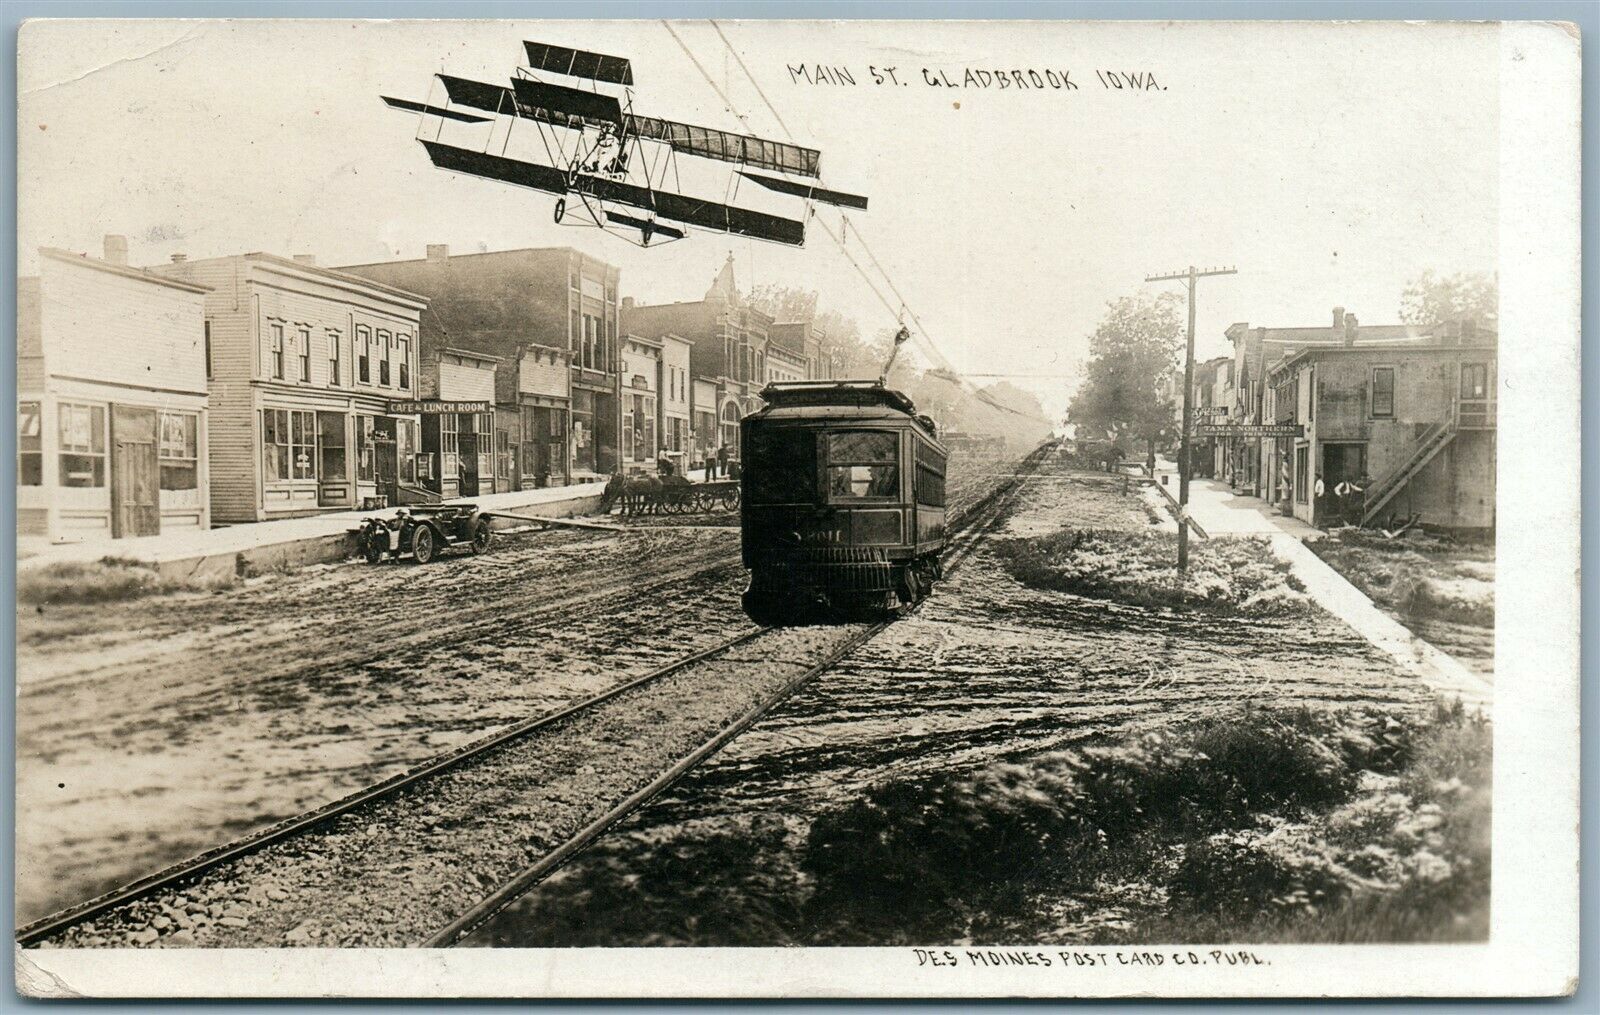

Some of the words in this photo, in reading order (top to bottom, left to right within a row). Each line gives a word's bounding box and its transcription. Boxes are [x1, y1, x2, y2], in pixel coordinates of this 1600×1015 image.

[390, 403, 414, 413] CAFE
[423, 403, 455, 413] LUNCH
[458, 403, 486, 413] ROOM
